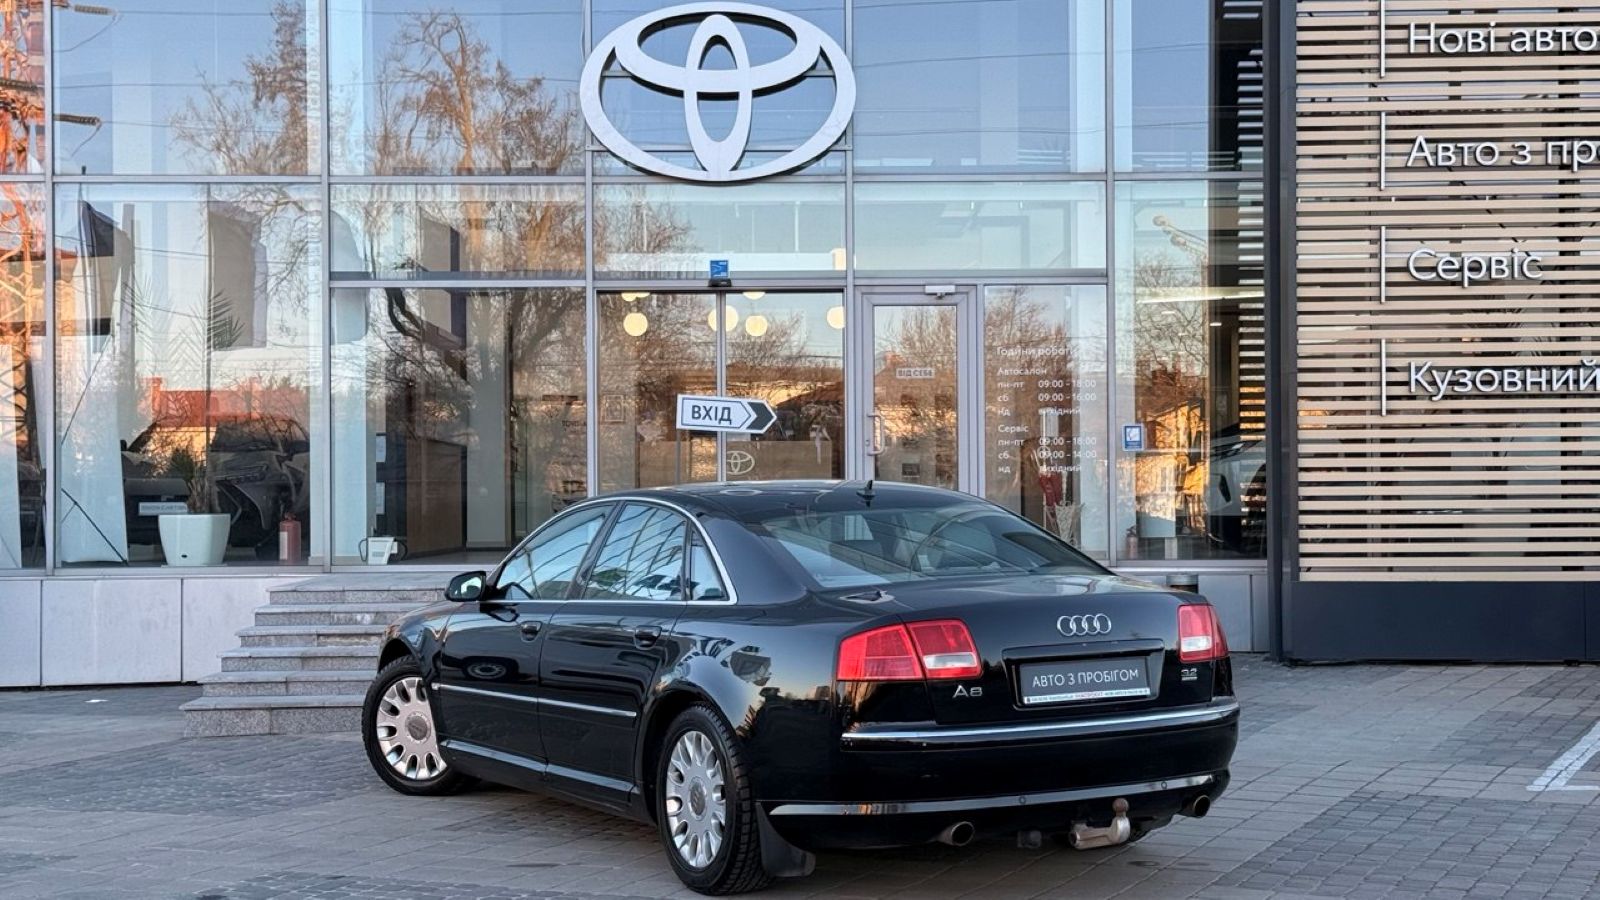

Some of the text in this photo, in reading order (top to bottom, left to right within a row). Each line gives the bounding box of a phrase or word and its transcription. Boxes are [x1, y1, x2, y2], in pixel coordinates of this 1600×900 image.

[1409, 21, 1598, 53] Нові авто
[1406, 135, 1600, 172] Авто з пр
[1408, 247, 1543, 288] Сервіс
[997, 367, 1047, 377] Автосалон
[1038, 379, 1063, 388] 09:00
[1409, 359, 1600, 401] Кузовний
[997, 392, 1009, 401] сб
[1038, 393, 1063, 402] 09:00
[691, 404, 732, 425] ВХІД
[1038, 406, 1080, 416] вхідний
[998, 424, 1029, 433] Сервіс
[998, 450, 1010, 459] сб
[998, 465, 1011, 473] нд
[1032, 674, 1066, 688] АВТО
[1077, 668, 1139, 684] ПРОБІГОМ
[952, 684, 983, 698] A8
